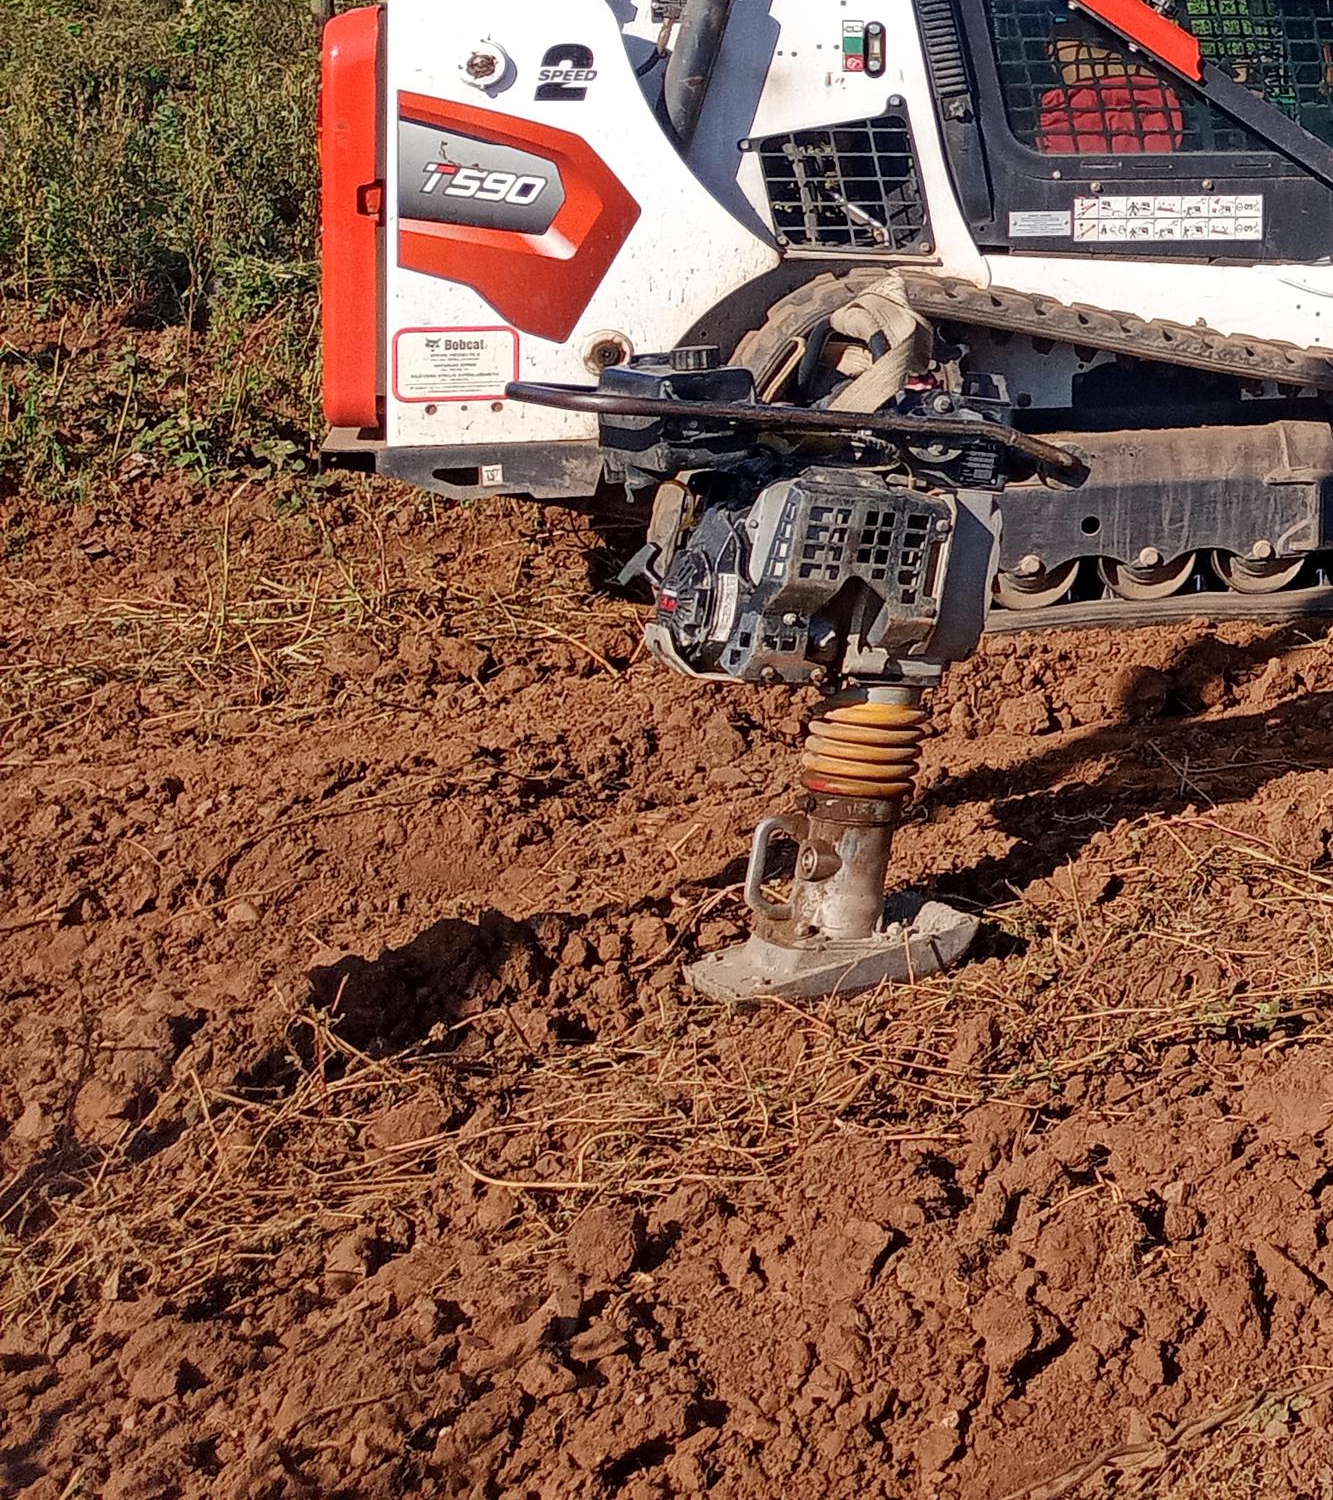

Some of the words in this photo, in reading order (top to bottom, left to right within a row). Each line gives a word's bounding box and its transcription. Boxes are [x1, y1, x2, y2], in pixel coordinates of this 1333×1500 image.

[538, 69, 598, 81] SPEED
[420, 162, 548, 206] T590
[444, 339, 484, 350] Bobcat
